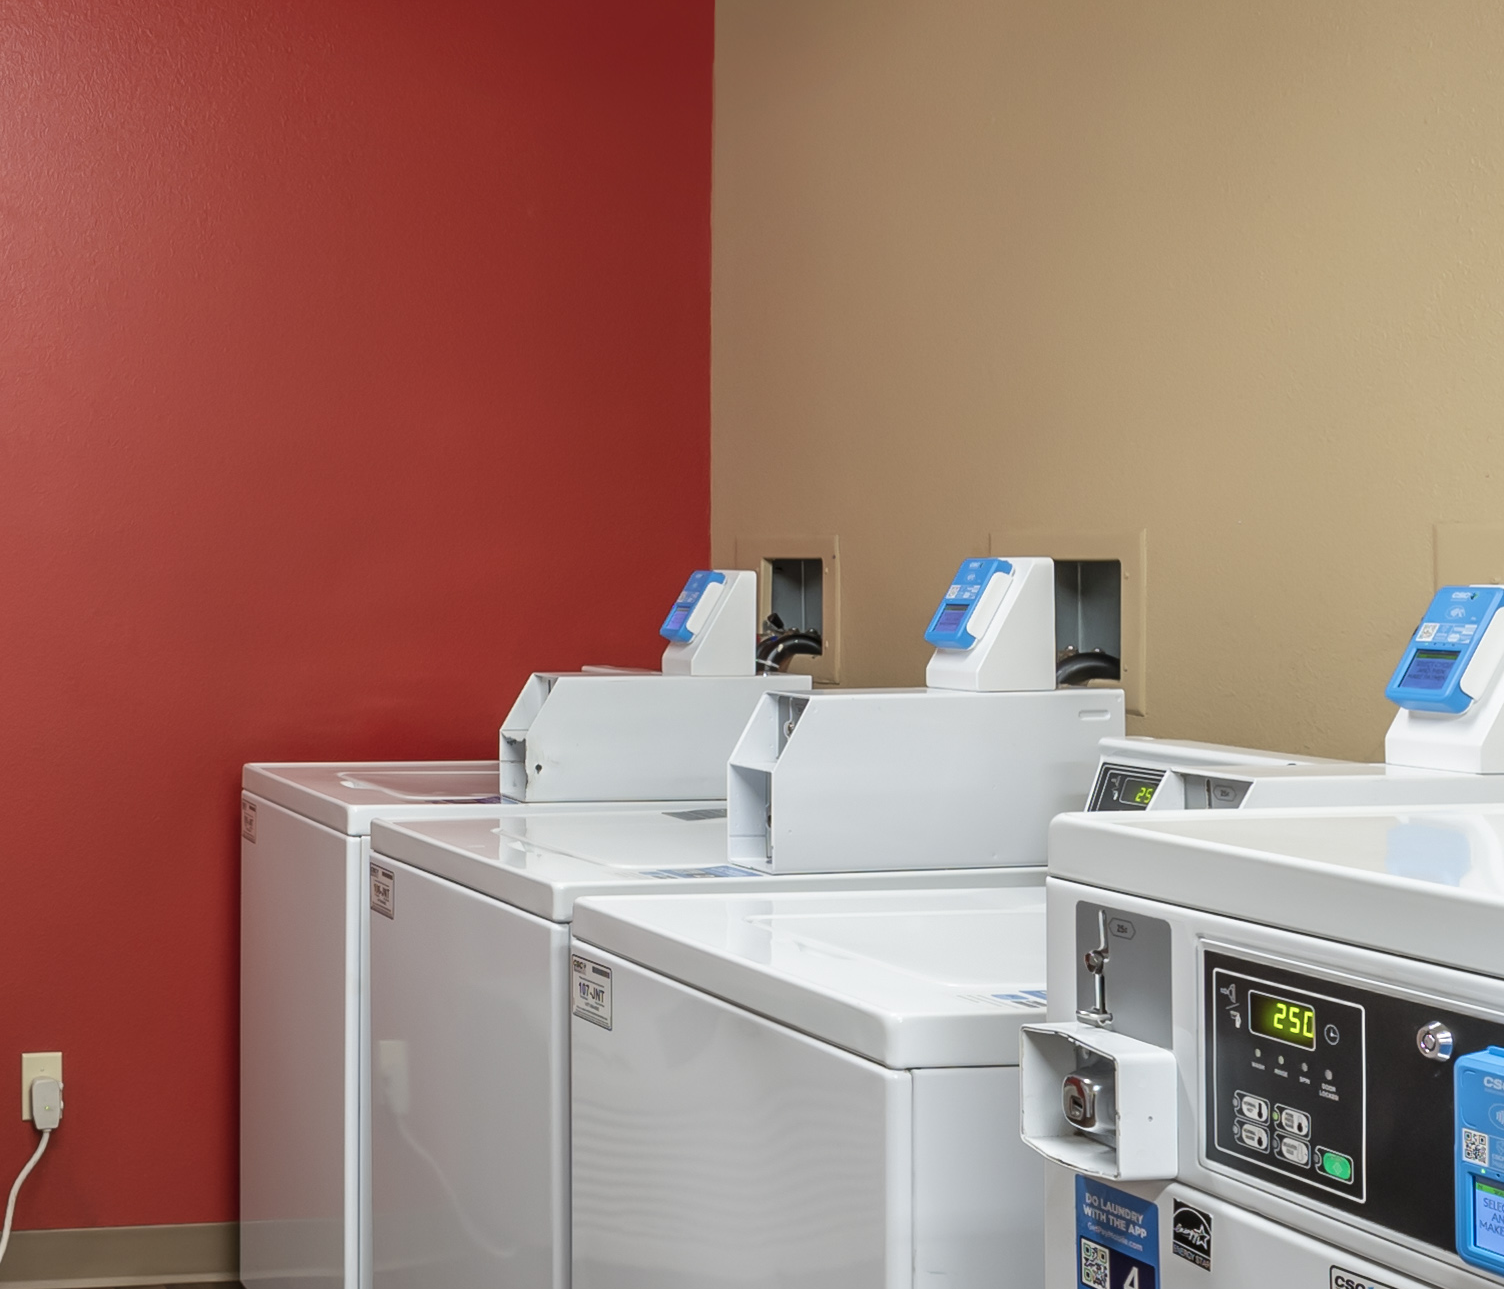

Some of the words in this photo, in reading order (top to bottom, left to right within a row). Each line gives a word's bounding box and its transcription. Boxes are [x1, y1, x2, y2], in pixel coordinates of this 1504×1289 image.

[578, 981, 605, 1003] 107-JNT
[1273, 1002, 1314, 1038] 250
[1083, 1204, 1107, 1223] WITH
[1108, 1214, 1126, 1230] THE
[1128, 1223, 1147, 1238] APP
[1085, 1192, 1099, 1208] DO
[1100, 1198, 1144, 1224] LAUNDRY
[1480, 1221, 1504, 1238] MAKE
